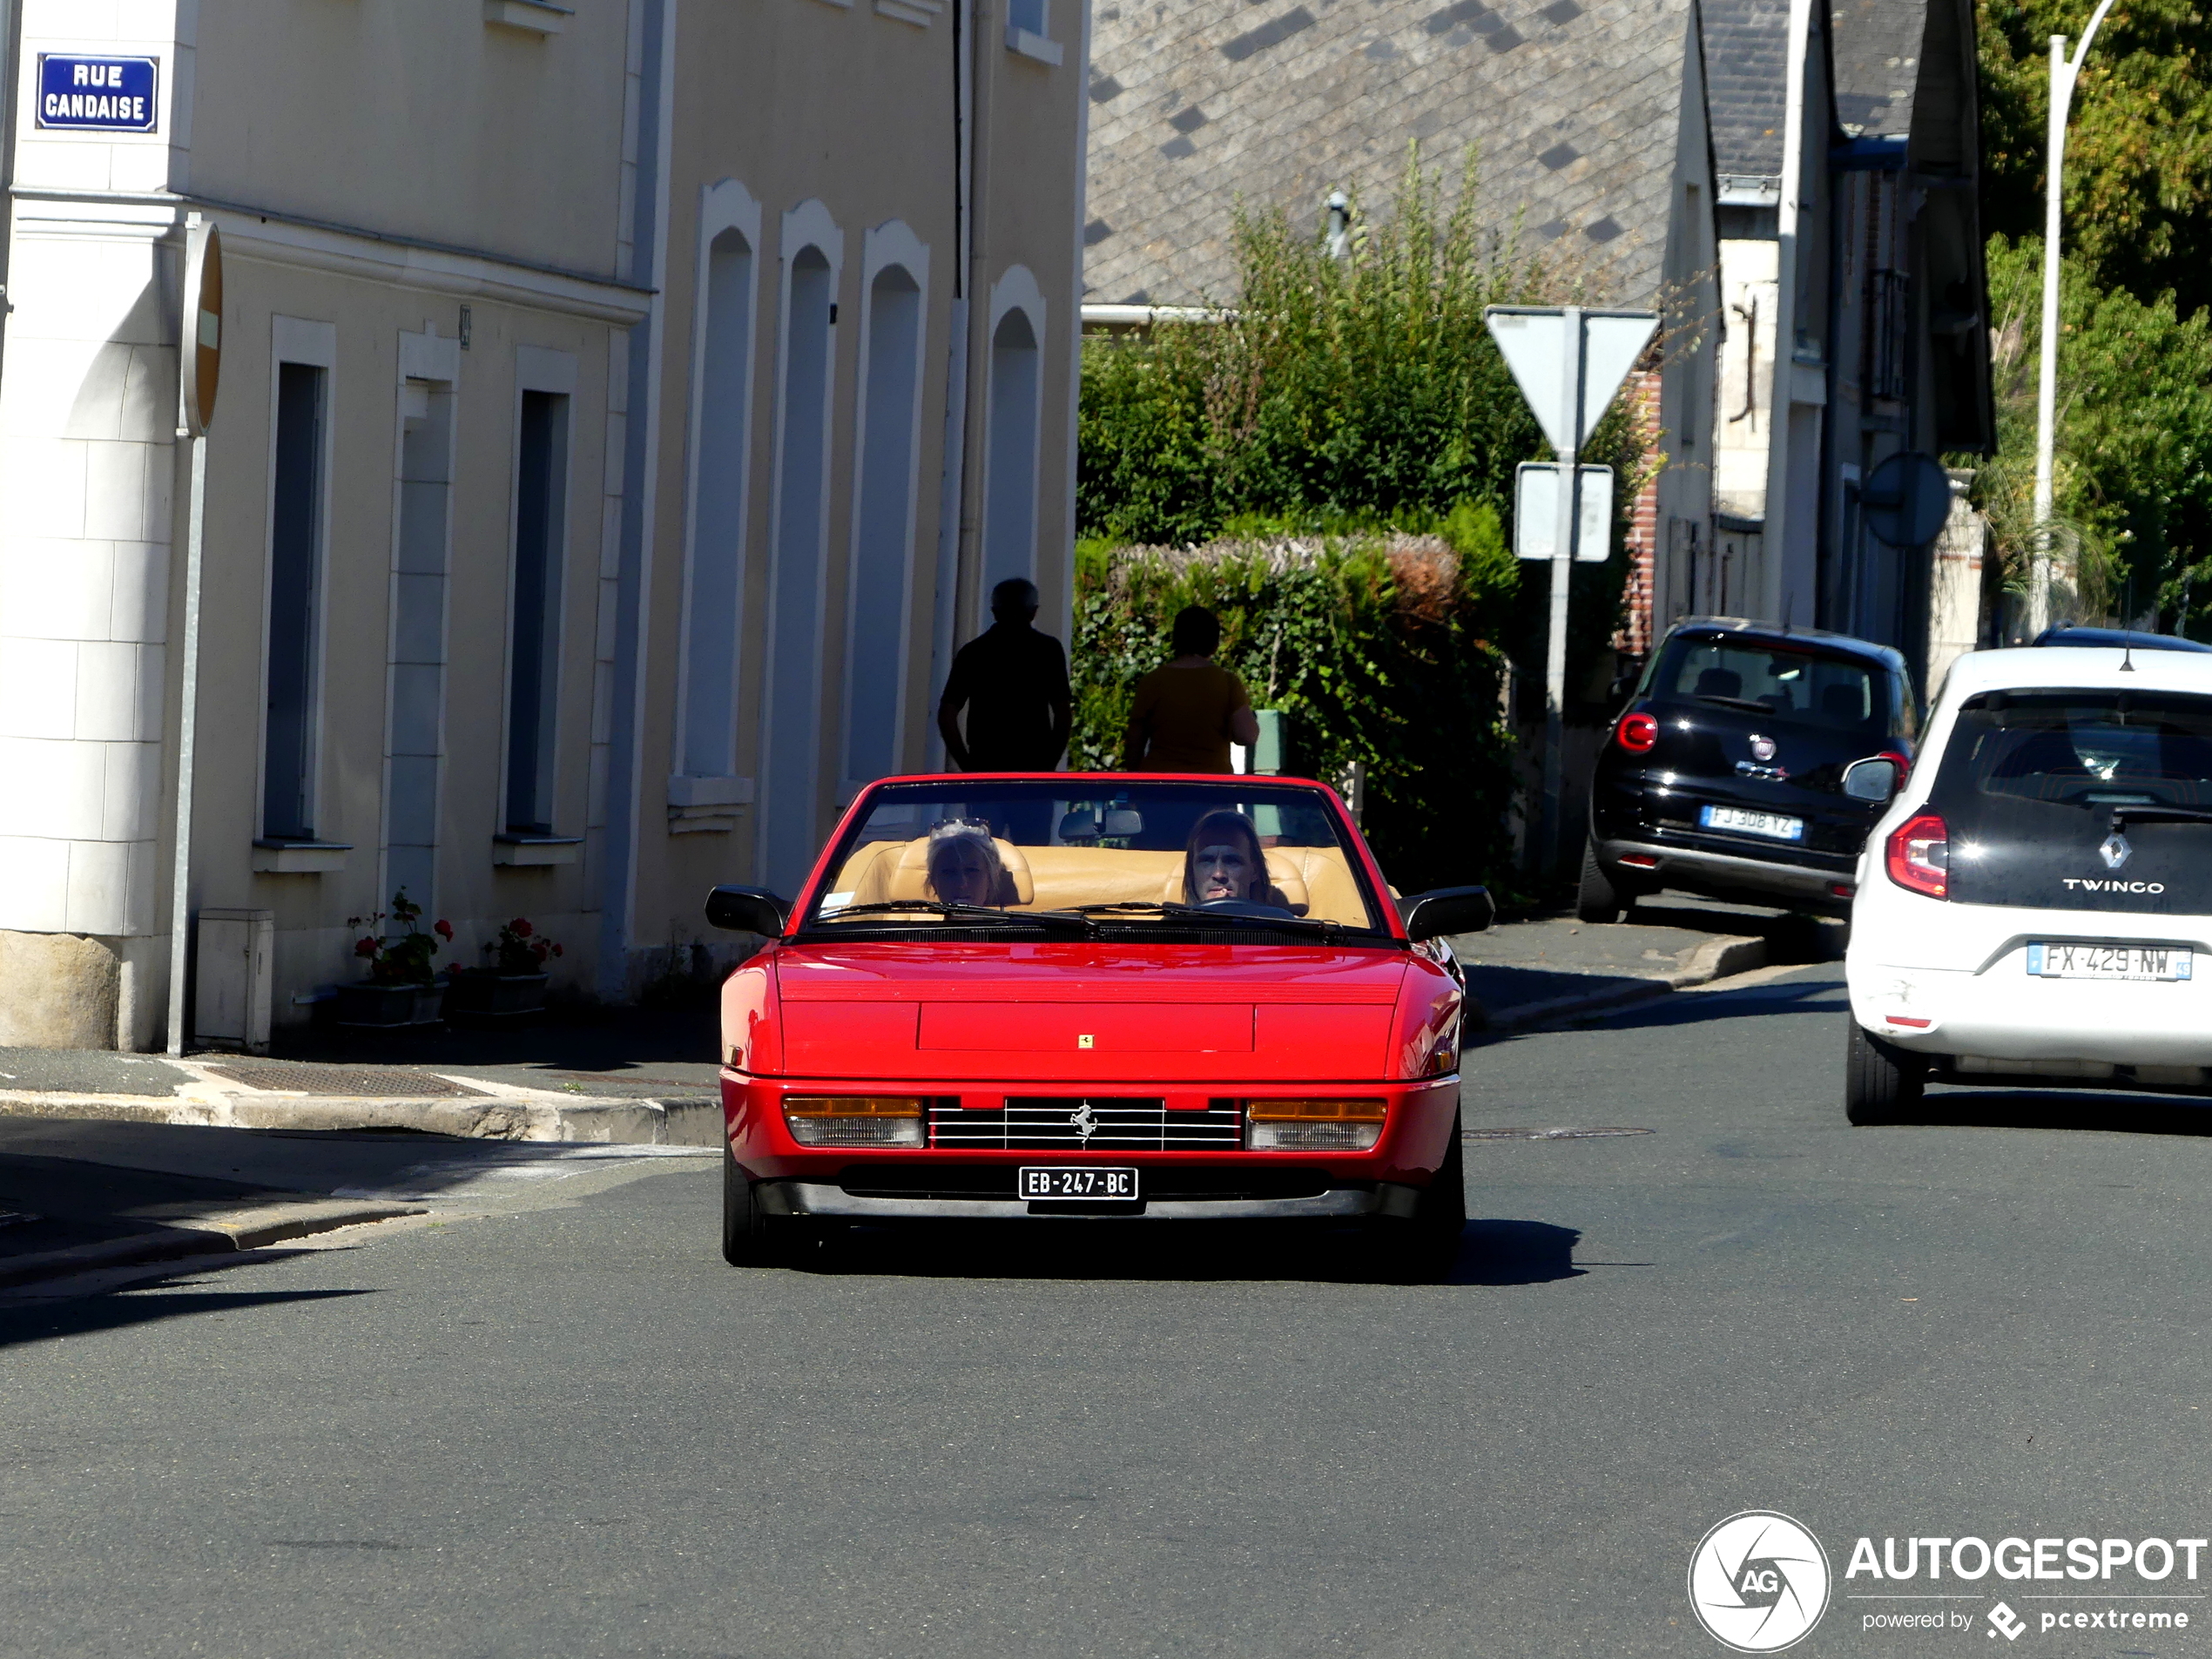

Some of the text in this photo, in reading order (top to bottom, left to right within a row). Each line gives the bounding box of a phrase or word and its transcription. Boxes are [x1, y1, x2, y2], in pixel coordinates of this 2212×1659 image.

[74, 64, 123, 88] RUE
[45, 93, 145, 121] CANDAISE
[2062, 879, 2165, 894] TWINGO
[2177, 962, 2191, 975] 49
[1028, 1172, 1129, 1194] EB-247-BC
